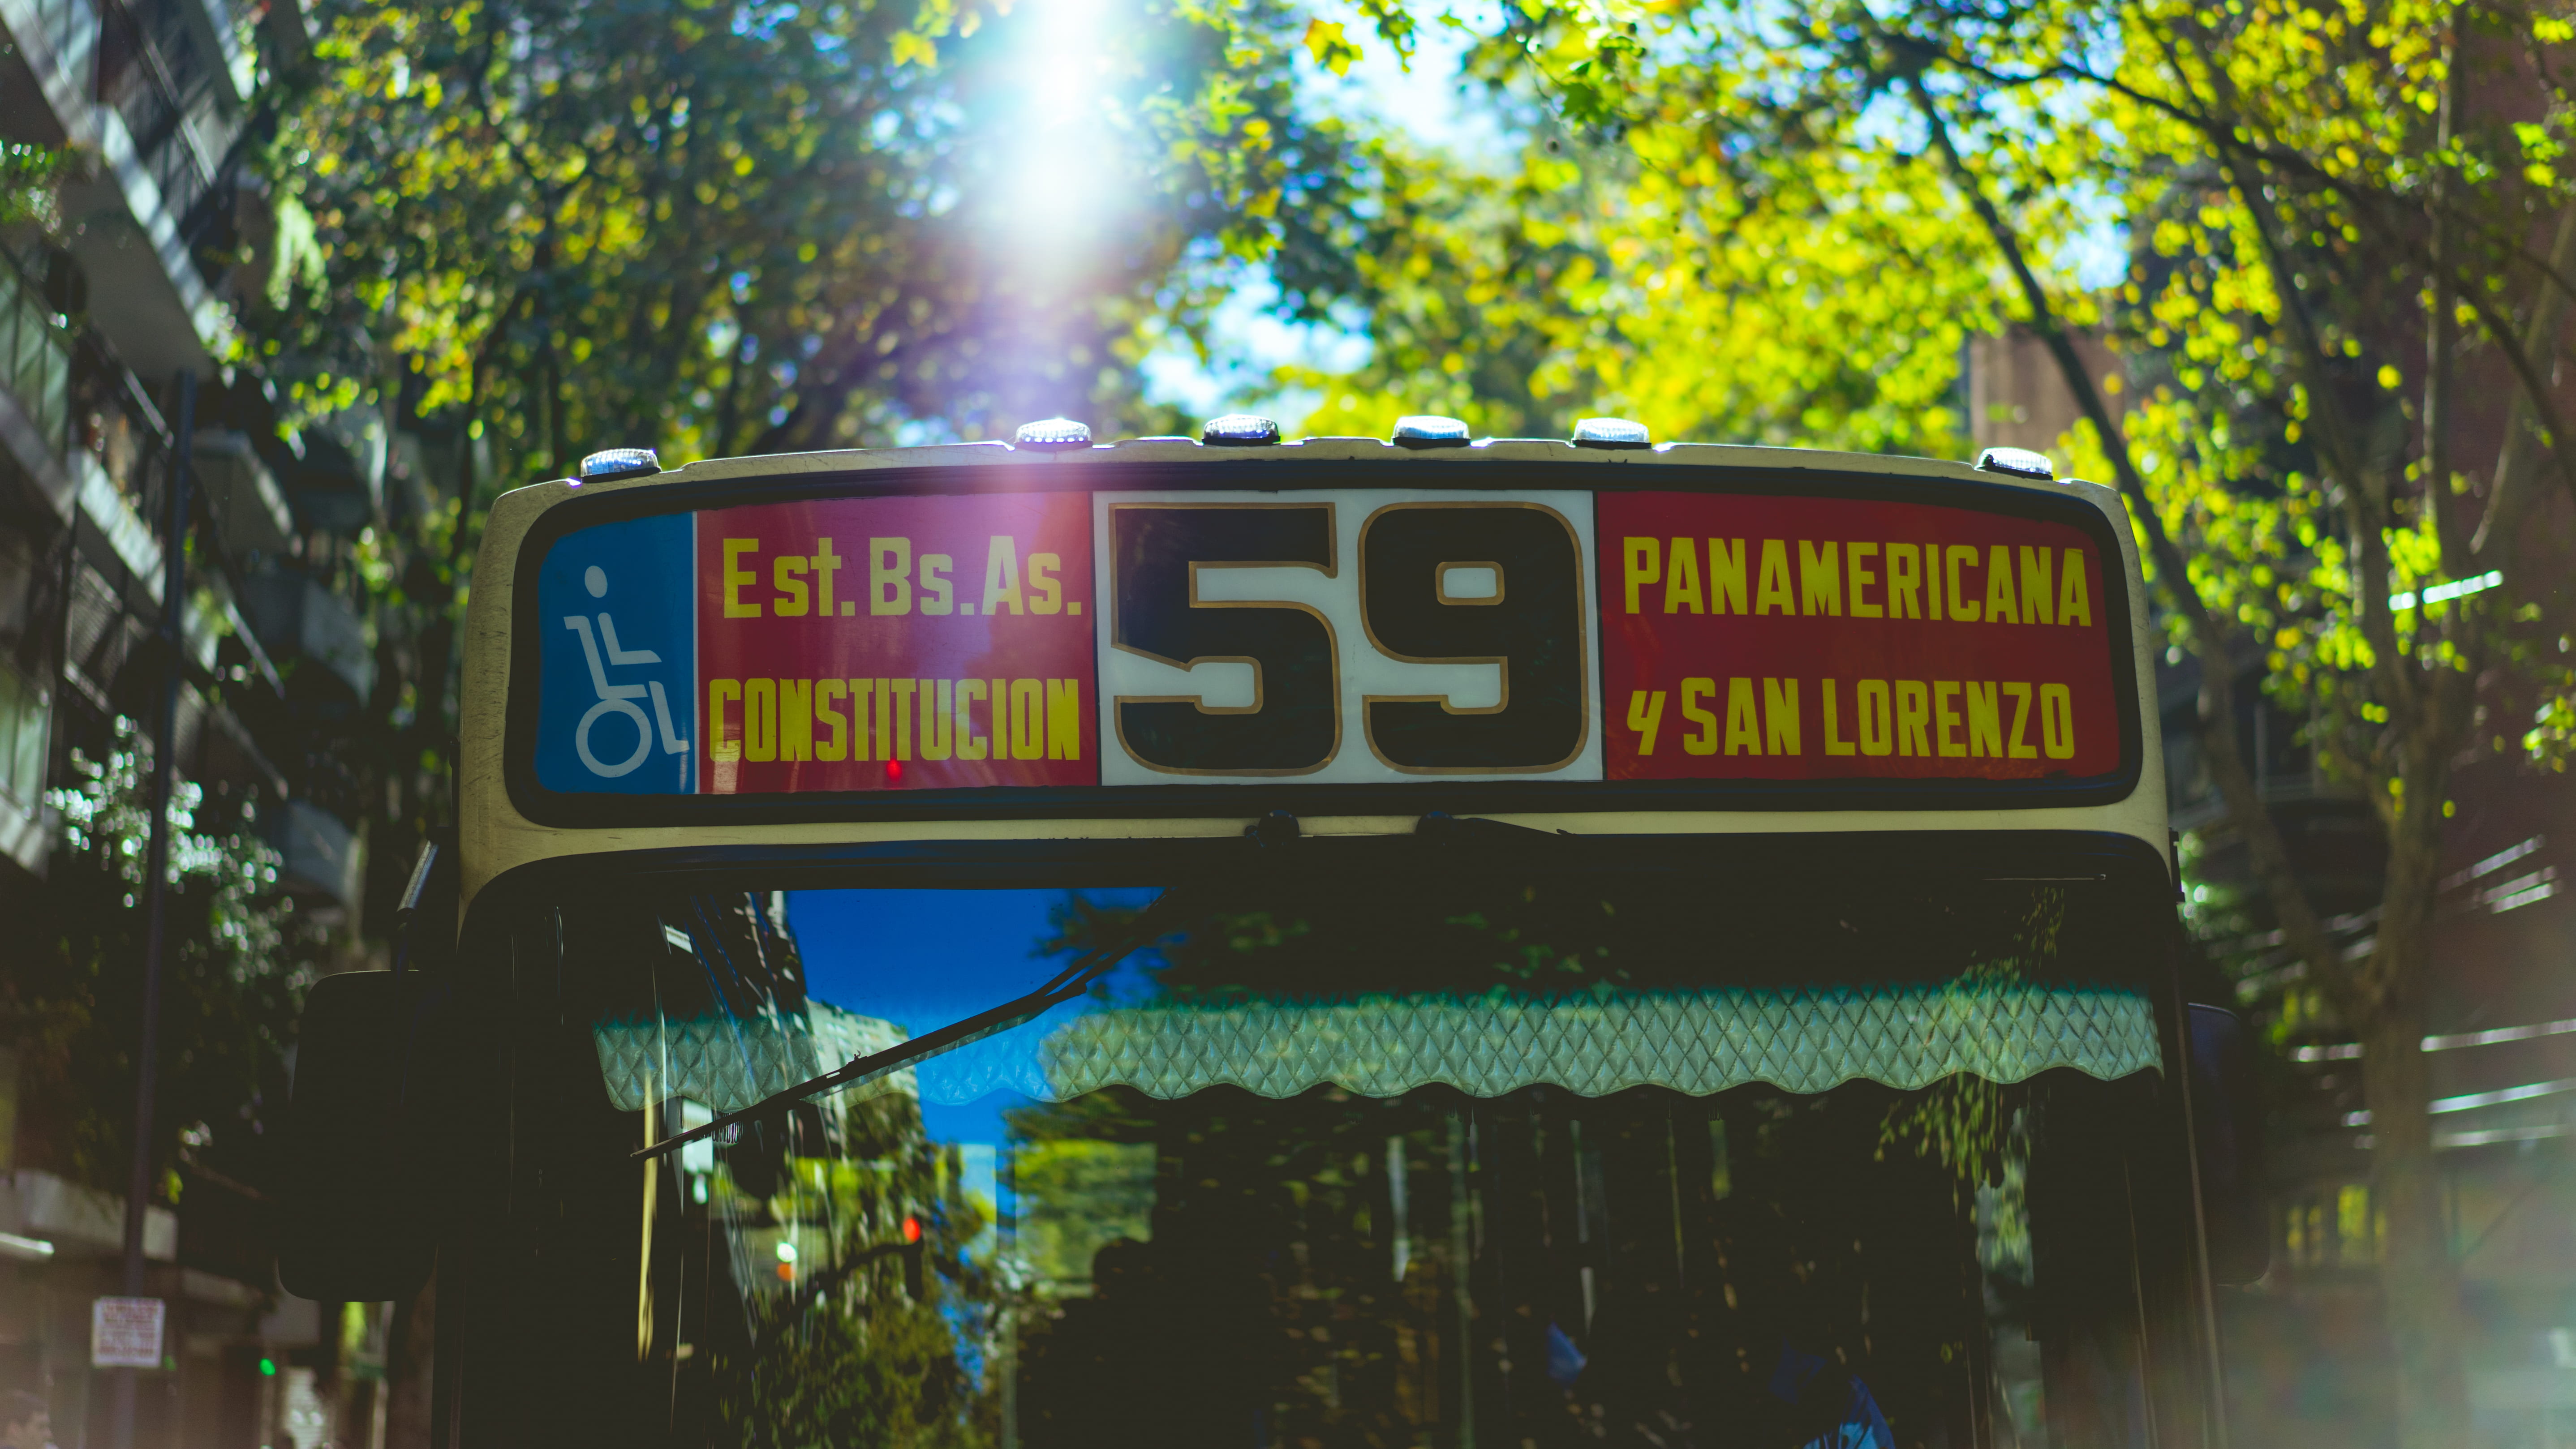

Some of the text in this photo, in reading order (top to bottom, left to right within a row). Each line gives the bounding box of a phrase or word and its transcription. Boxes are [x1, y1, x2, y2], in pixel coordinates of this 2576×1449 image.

[1623, 536, 2092, 627] PANAMERICANA
[1108, 501, 1589, 777] 59
[709, 678, 1080, 763] CONSTITUCION
[1680, 677, 1802, 756] SAN
[1822, 678, 2076, 760] LORENZO
